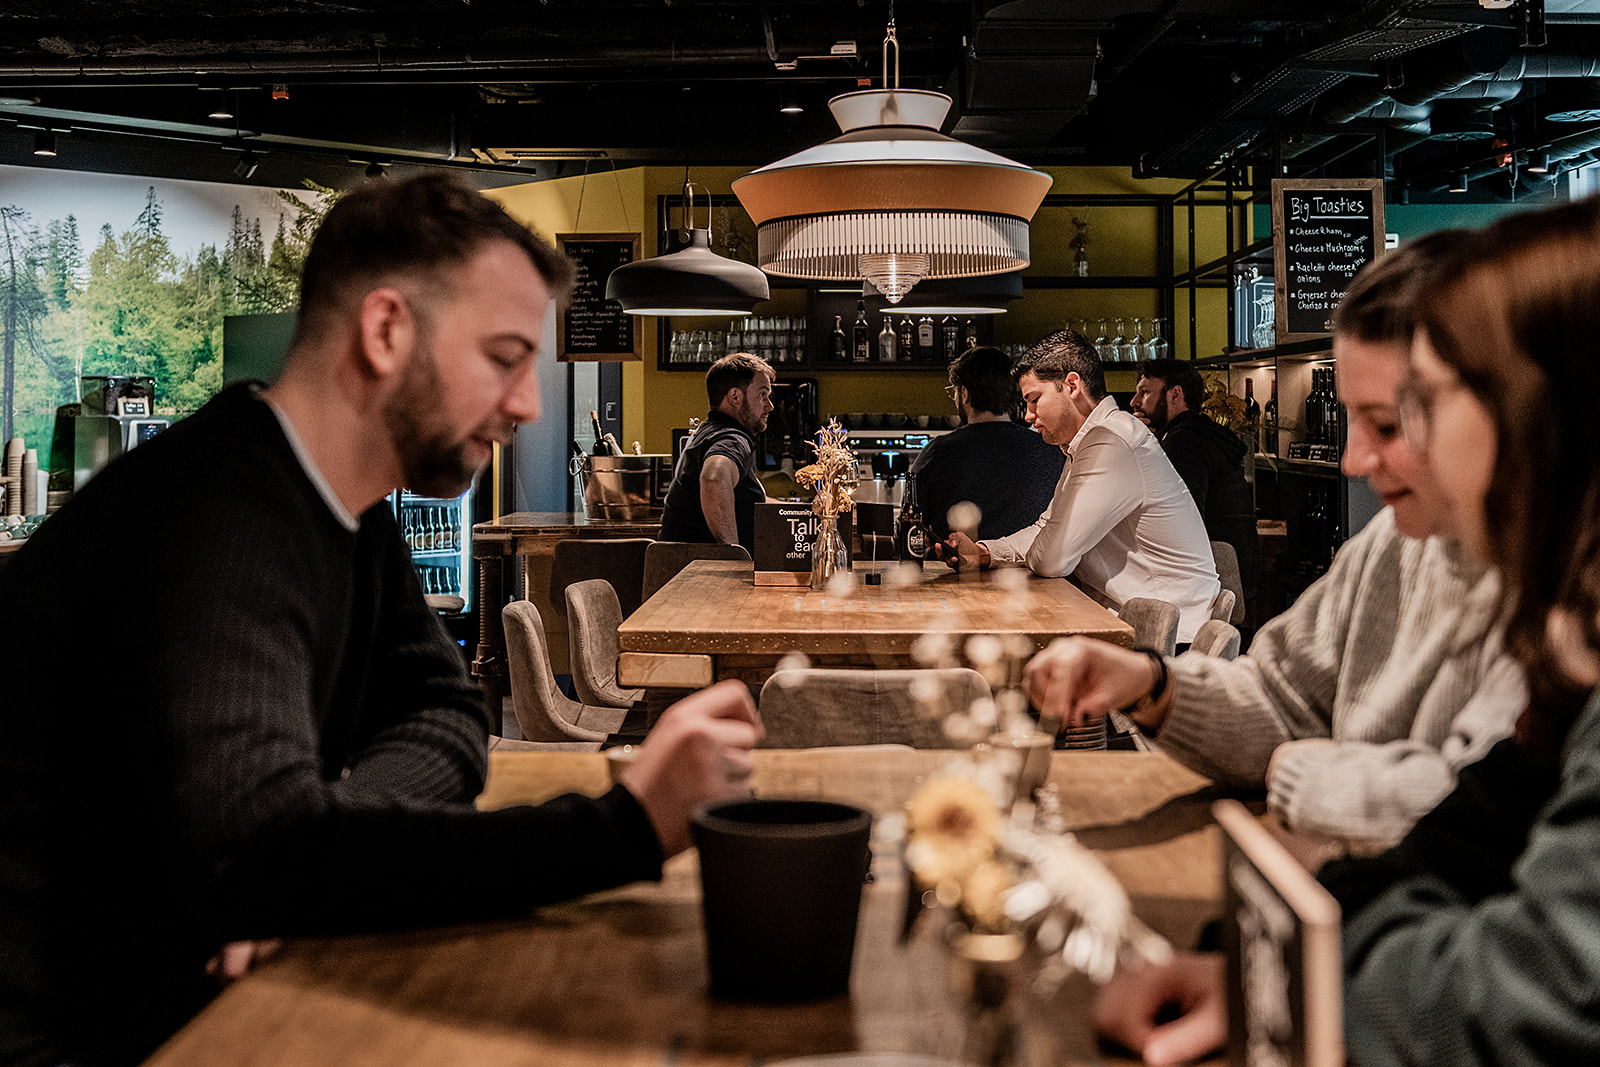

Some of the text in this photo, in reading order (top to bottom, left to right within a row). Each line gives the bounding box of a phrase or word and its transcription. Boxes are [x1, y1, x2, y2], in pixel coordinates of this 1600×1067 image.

[1291, 196, 1365, 223] Big Toasties
[1296, 274, 1321, 284] onions
[778, 509, 813, 517] Community
[786, 518, 822, 536] Talk
[793, 532, 805, 542] to
[794, 542, 816, 552] eac
[786, 551, 806, 559] other
